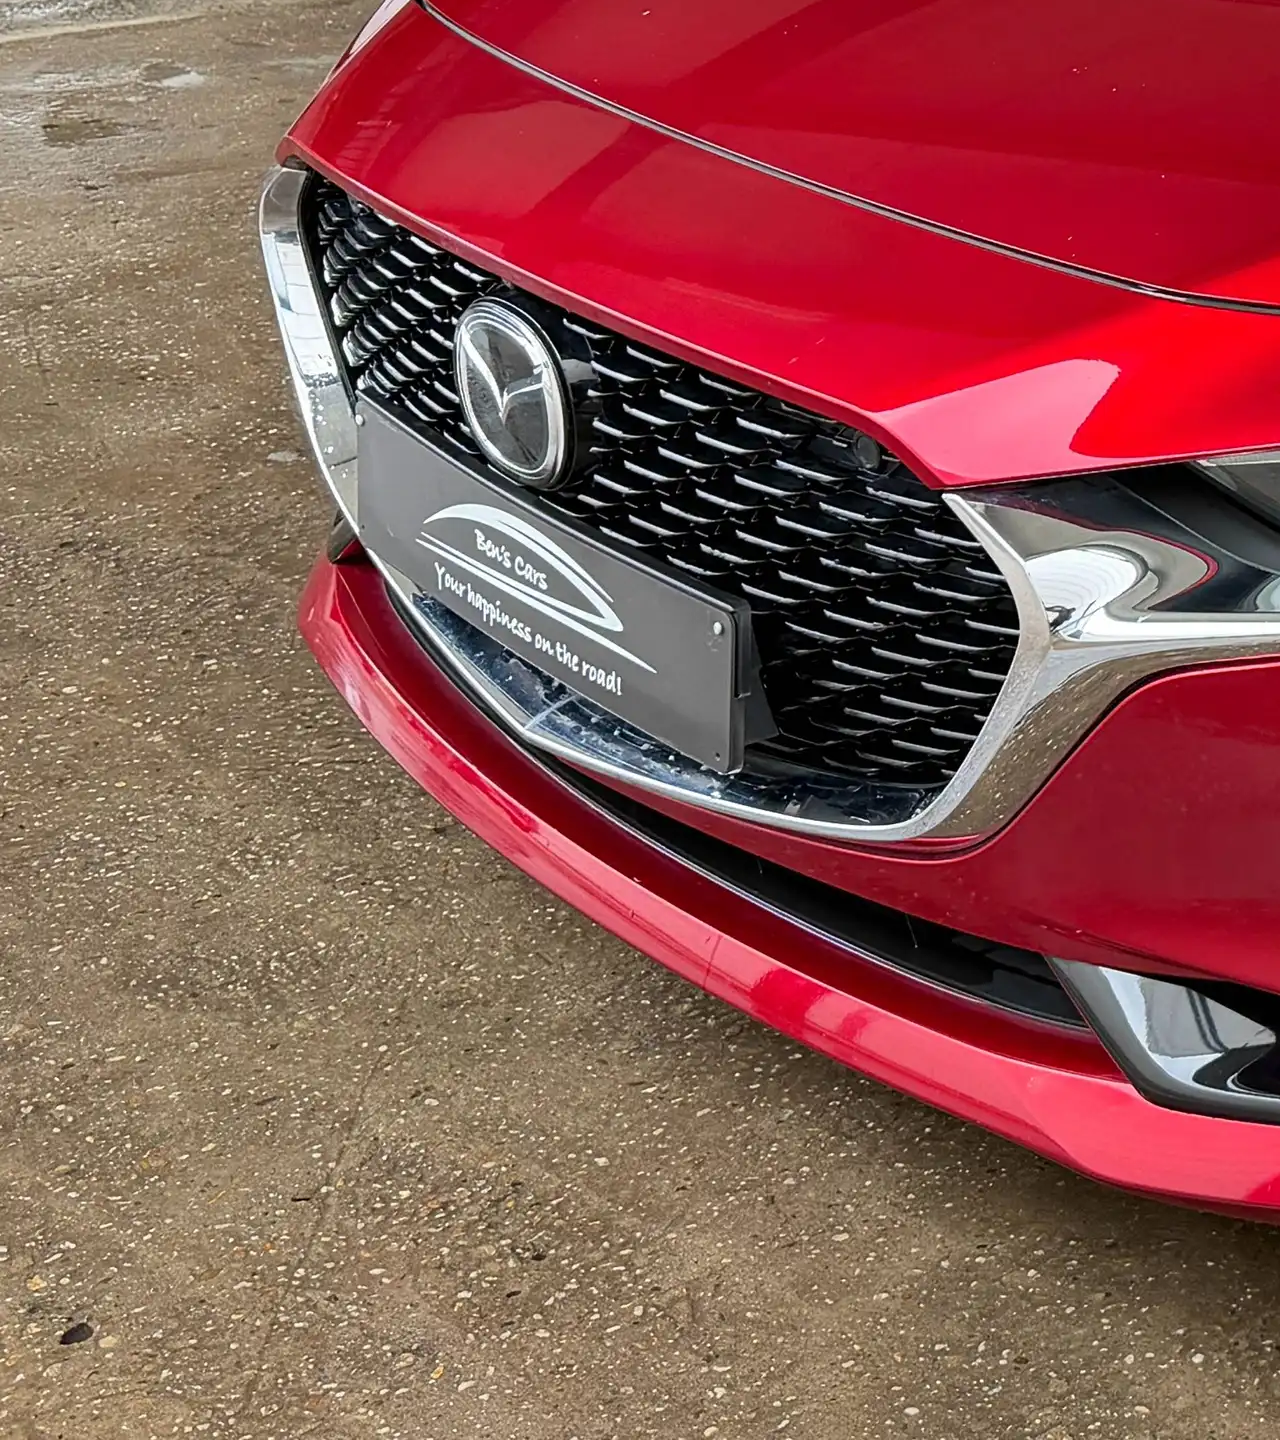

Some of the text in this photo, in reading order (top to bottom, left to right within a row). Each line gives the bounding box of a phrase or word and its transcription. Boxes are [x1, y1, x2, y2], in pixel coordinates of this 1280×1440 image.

[474, 529, 548, 591] Ben's Cars
[434, 561, 466, 597] Your
[467, 582, 533, 643] happiness
[556, 642, 579, 672] the
[582, 662, 622, 696] road!
